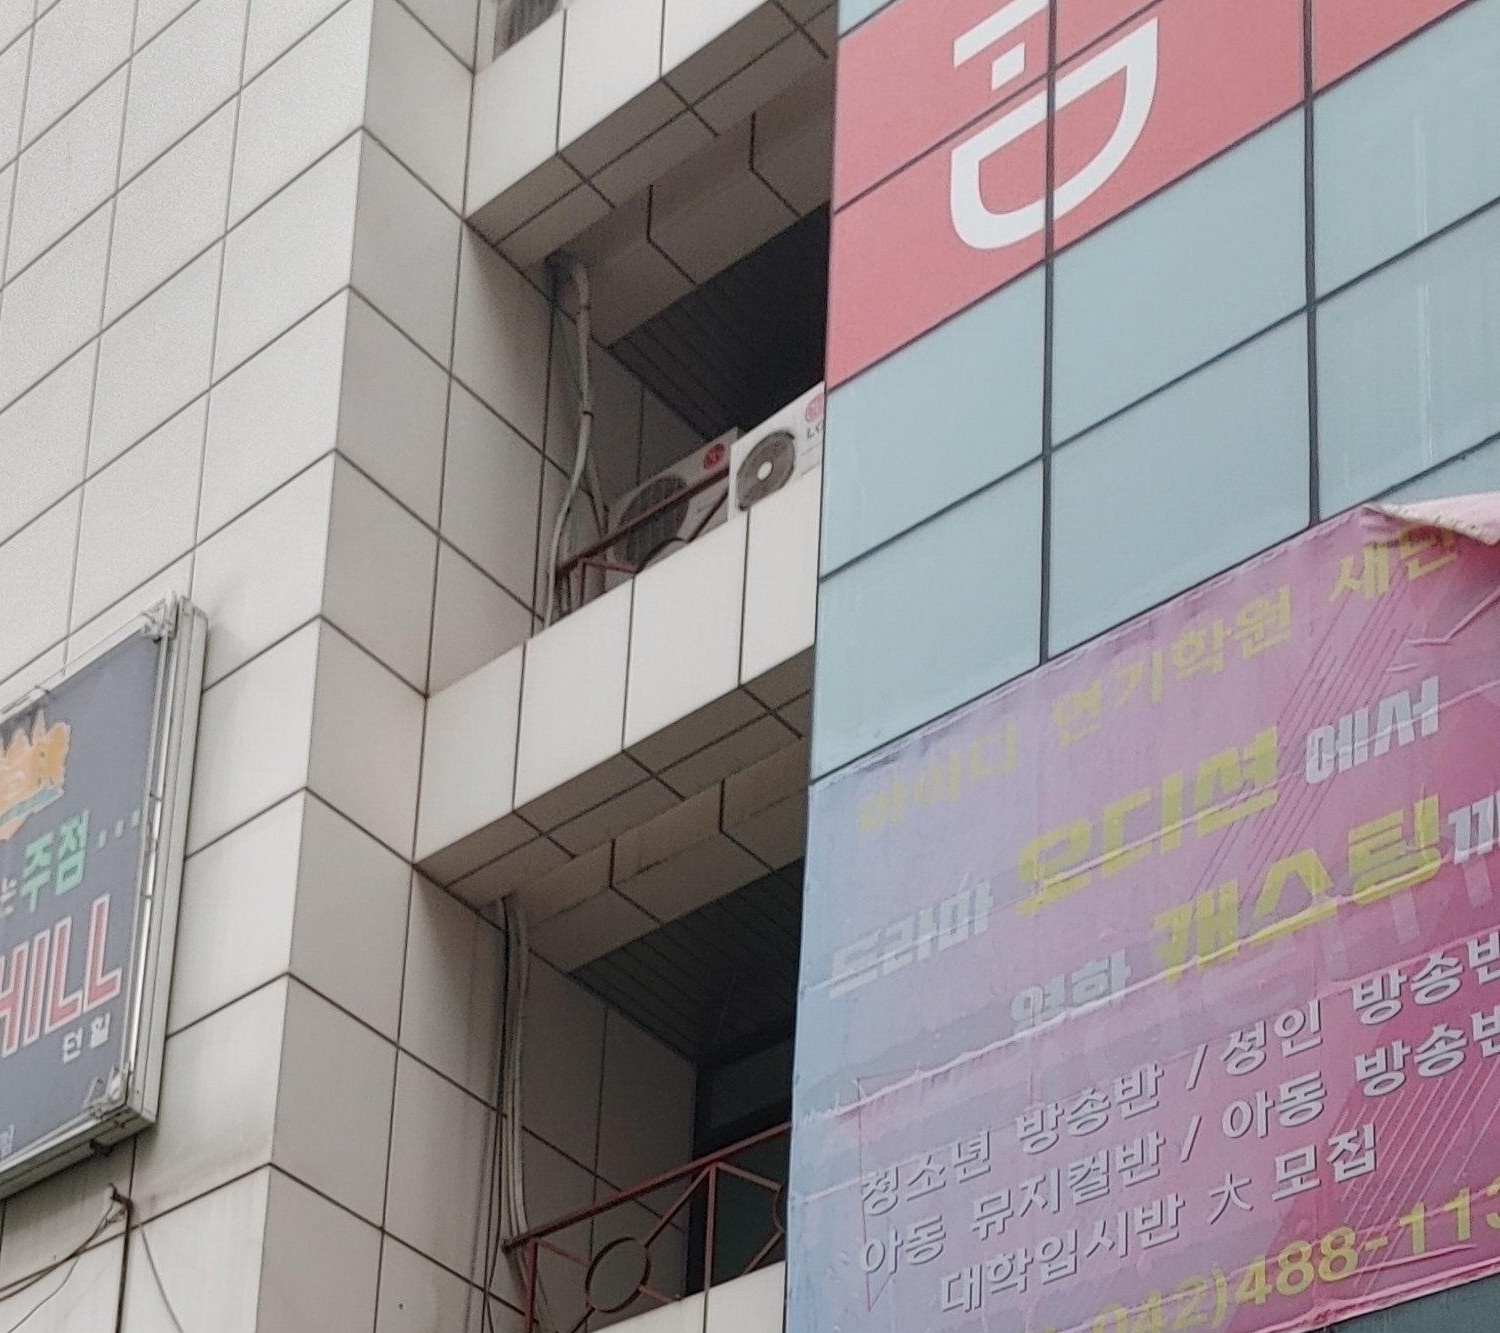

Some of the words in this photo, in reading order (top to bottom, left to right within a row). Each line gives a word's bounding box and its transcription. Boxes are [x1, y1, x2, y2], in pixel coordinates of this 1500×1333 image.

[1049, 585, 1292, 748] 연기학원
[829, 880, 994, 1000] 드라마
[1014, 725, 1278, 919] 오디션
[1305, 675, 1441, 784] 에서
[1151, 793, 1441, 985] 캐스팅
[62, 1012, 111, 1064] 던힐
[861, 1129, 993, 1217] 청소년
[1015, 1063, 1165, 1156] 방송반
[1219, 998, 1325, 1077] 성인
[858, 1212, 947, 1279] 아동
[970, 1130, 1166, 1242] 뮤지컬반
[1220, 1074, 1328, 1140] 아동
[940, 1193, 1185, 1317] 대학입시반
[1207, 1170, 1255, 1226] 大
[1271, 1122, 1378, 1202] 모집
